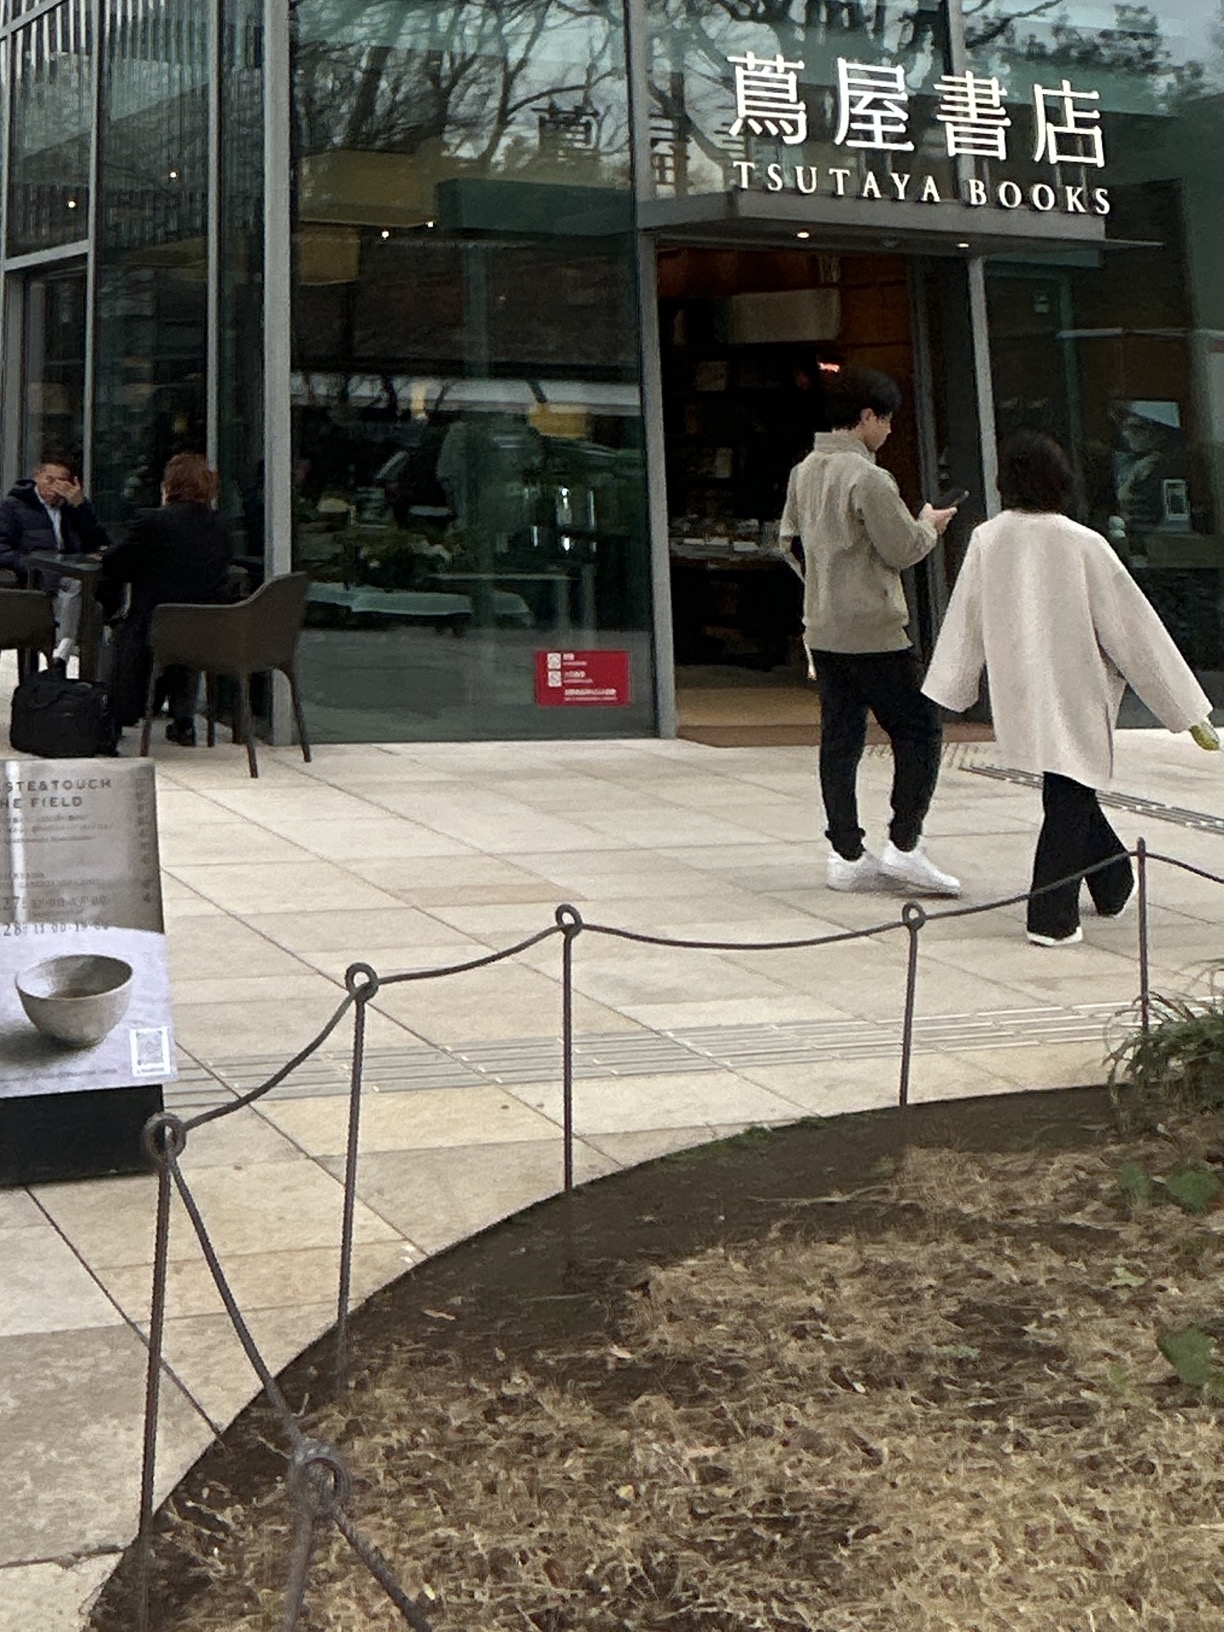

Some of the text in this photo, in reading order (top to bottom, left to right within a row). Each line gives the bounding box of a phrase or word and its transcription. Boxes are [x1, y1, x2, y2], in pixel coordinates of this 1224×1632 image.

[727, 51, 1106, 169] 蔦屋書店
[732, 160, 1111, 215] TSUTAYA BOOKS
[29, 796, 83, 808] FIELD
